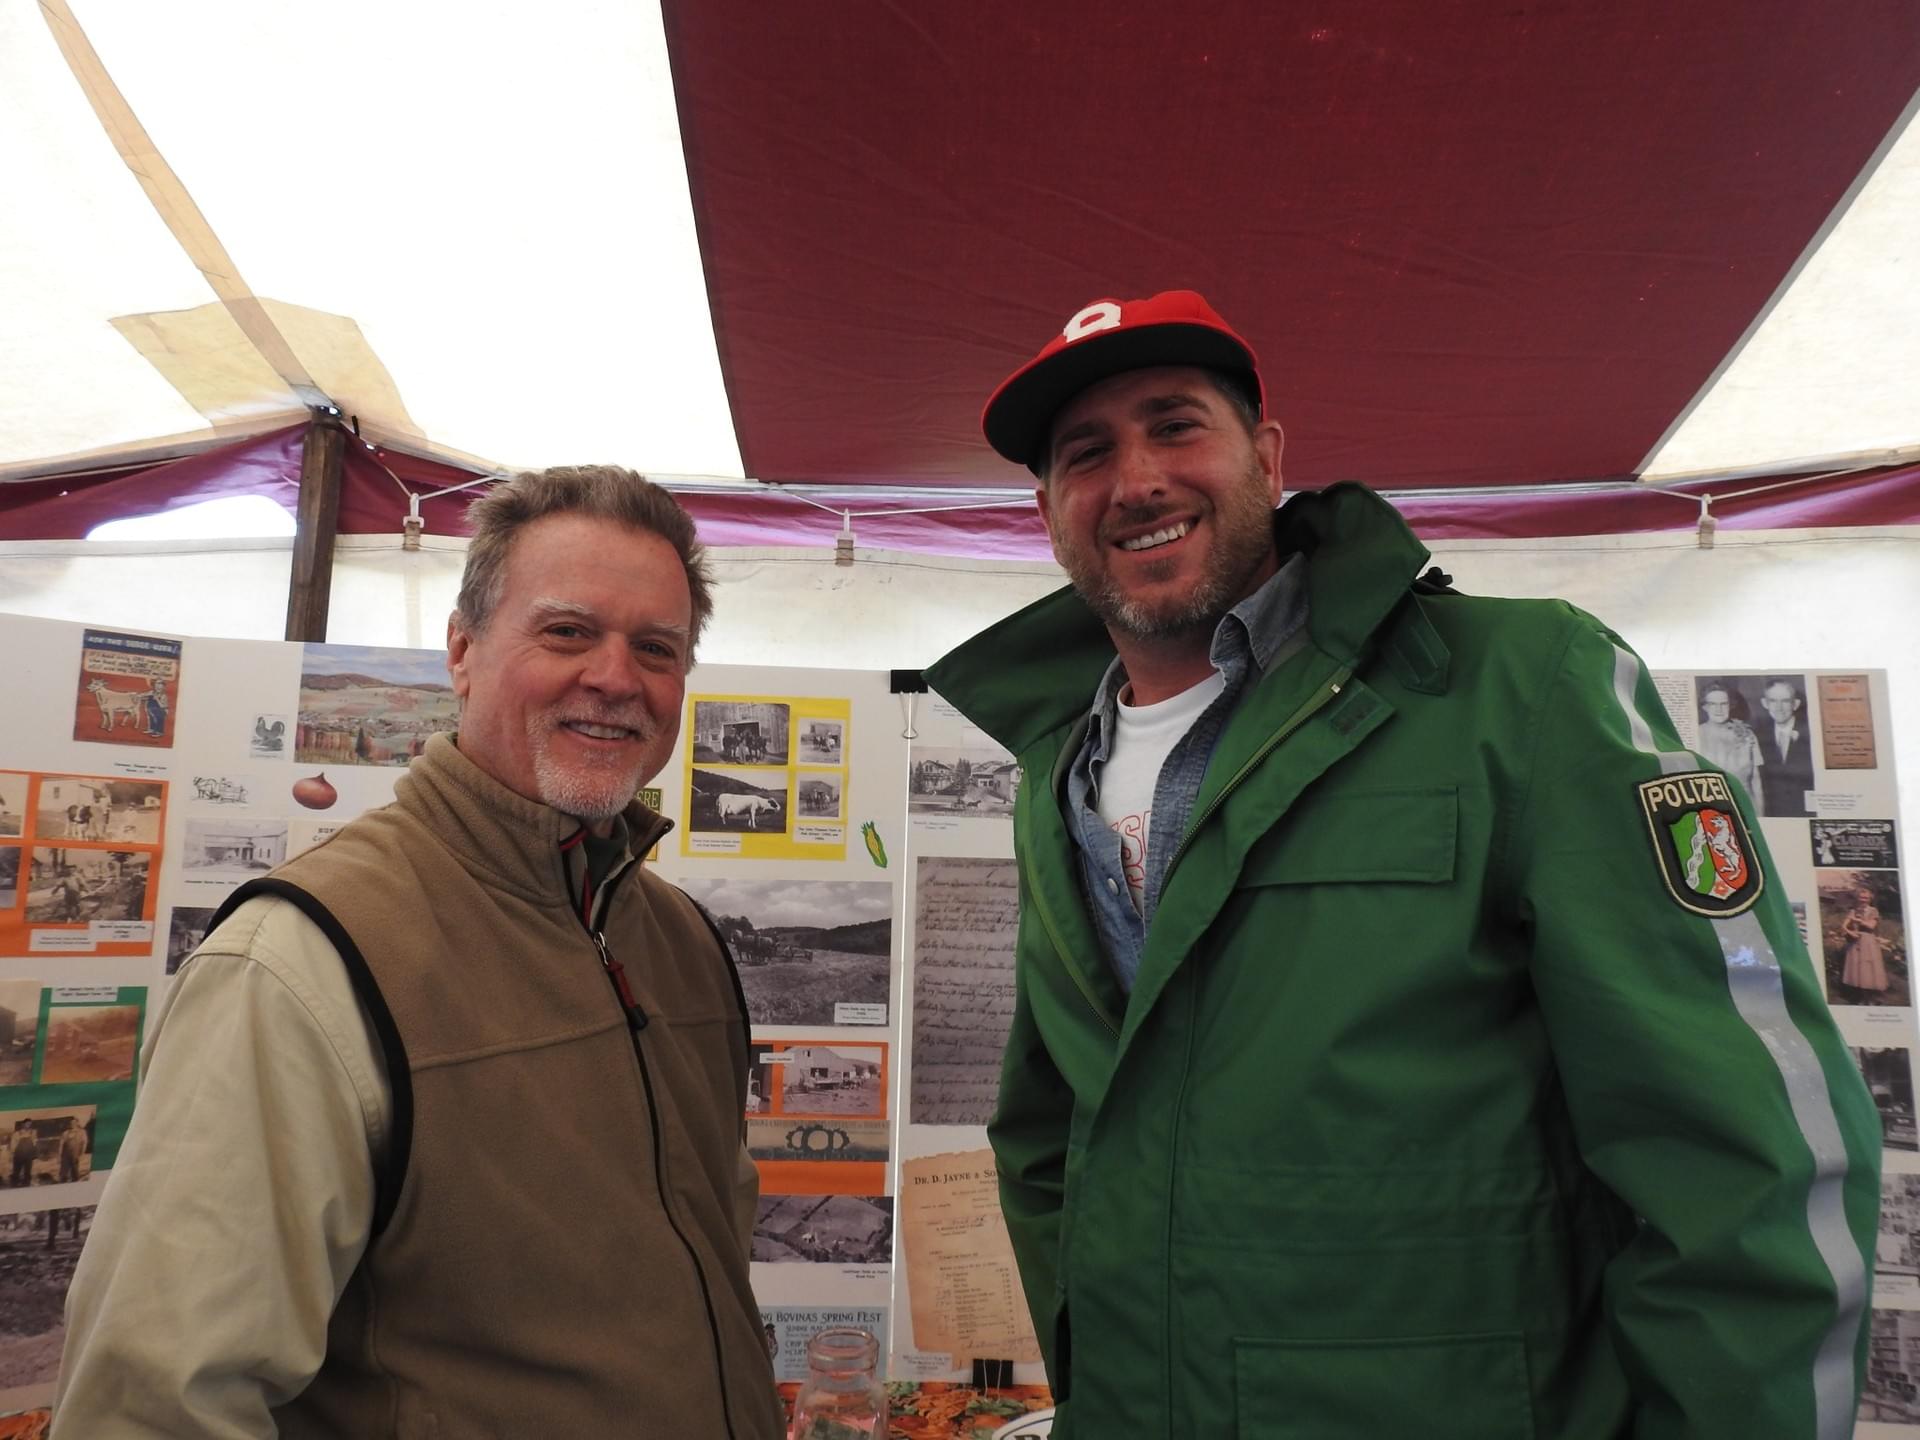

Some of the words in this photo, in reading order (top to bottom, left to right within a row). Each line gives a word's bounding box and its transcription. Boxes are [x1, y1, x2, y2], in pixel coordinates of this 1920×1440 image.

[1647, 777, 1729, 812] POLIZEI
[943, 1171, 971, 1184] JAYNE
[984, 1169, 996, 1178] SO
[821, 1311, 854, 1324] SPRING
[857, 1311, 882, 1323] FEST
